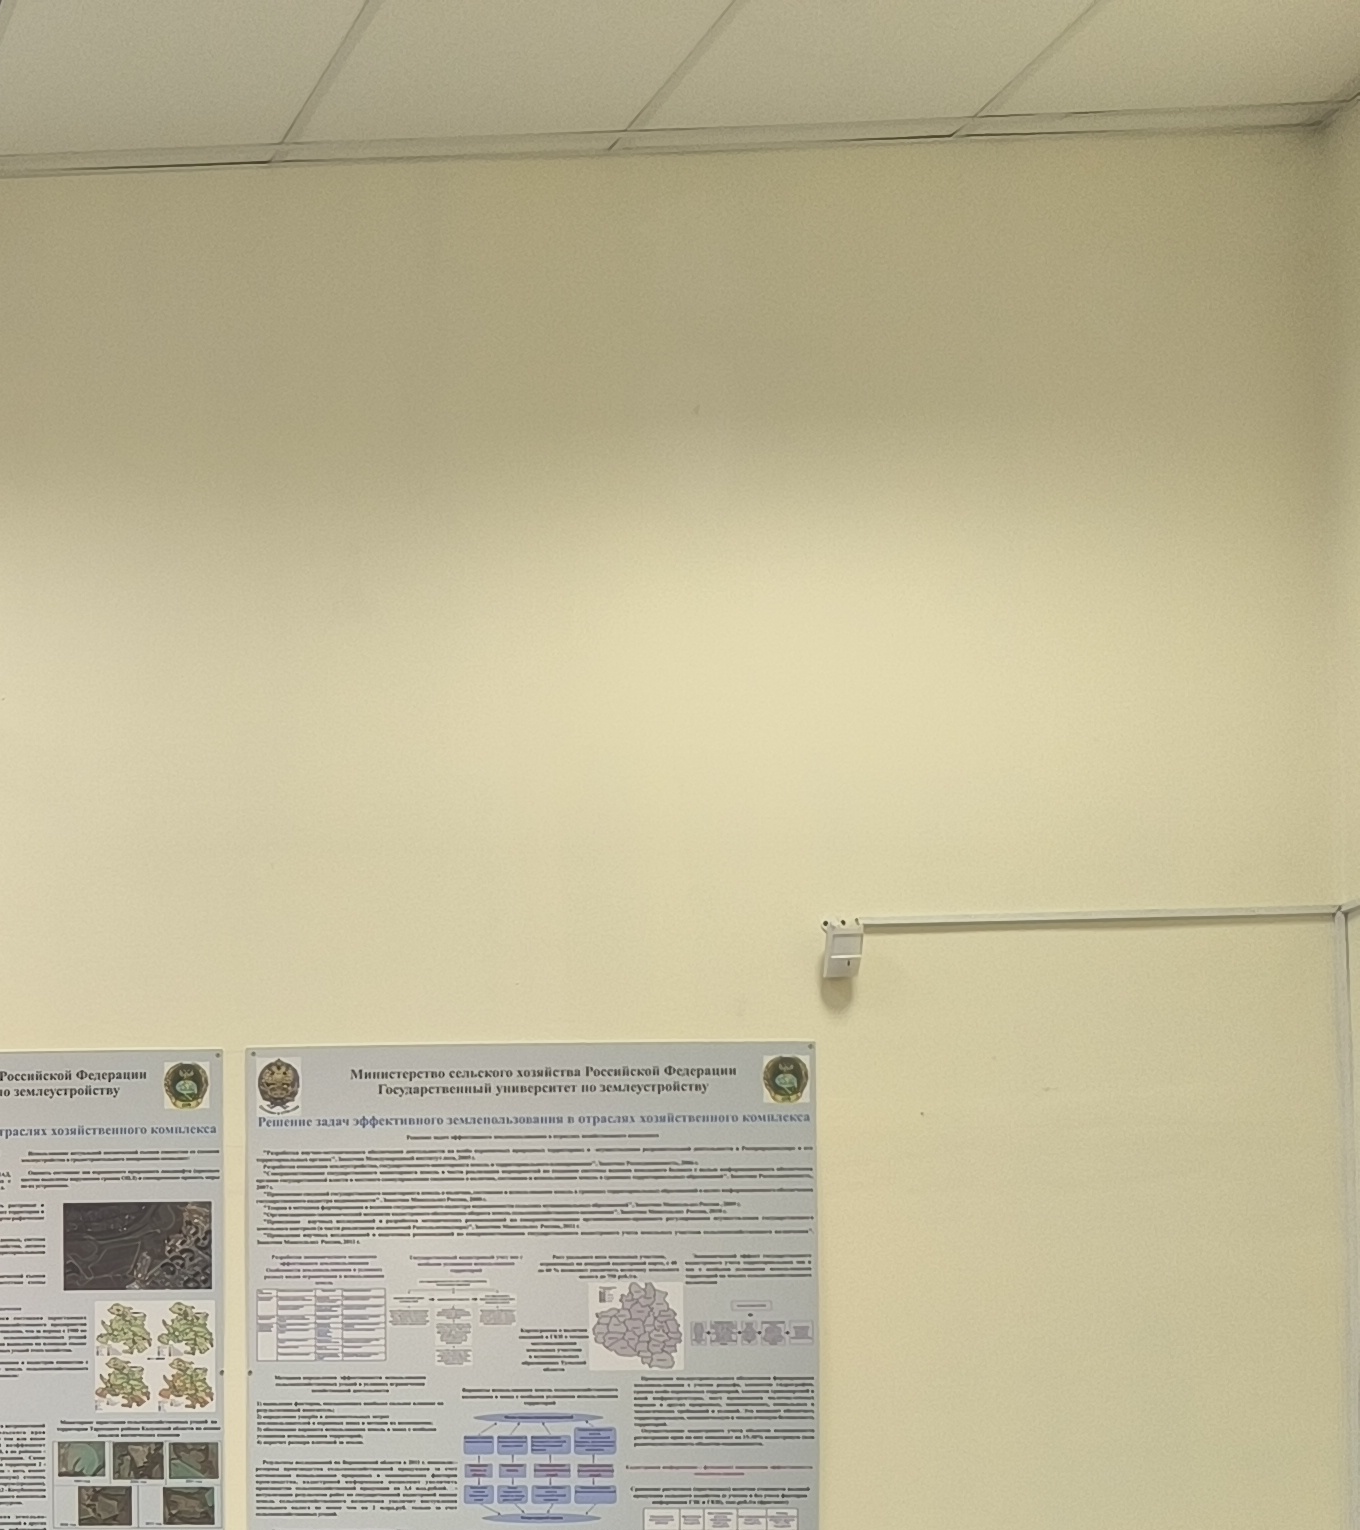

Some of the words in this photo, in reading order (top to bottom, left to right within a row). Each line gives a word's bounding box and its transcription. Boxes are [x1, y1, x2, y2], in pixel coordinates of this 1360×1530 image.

[0, 1070, 72, 1081] Российской
[76, 1070, 146, 1082] Федерации
[351, 1069, 445, 1081] Министерство
[449, 1070, 513, 1078] сельского
[517, 1067, 580, 1077] хозяйства
[586, 1066, 659, 1077] Российской
[664, 1066, 736, 1078] Федерации
[14, 1085, 120, 1099] землеустройству
[379, 1083, 491, 1097] Государственный
[496, 1085, 577, 1096] университет
[600, 1081, 709, 1095] землеустройству
[259, 1117, 312, 1127] Решение
[316, 1118, 349, 1127] задач
[353, 1116, 443, 1128] эффективного
[447, 1116, 563, 1125] землепользования
[578, 1116, 635, 1126] отраслях
[640, 1113, 738, 1123] хозяйственного
[743, 1114, 810, 1123] комплекса
[51, 1125, 147, 1136] хозяйственного
[151, 1126, 216, 1136] комплекса
